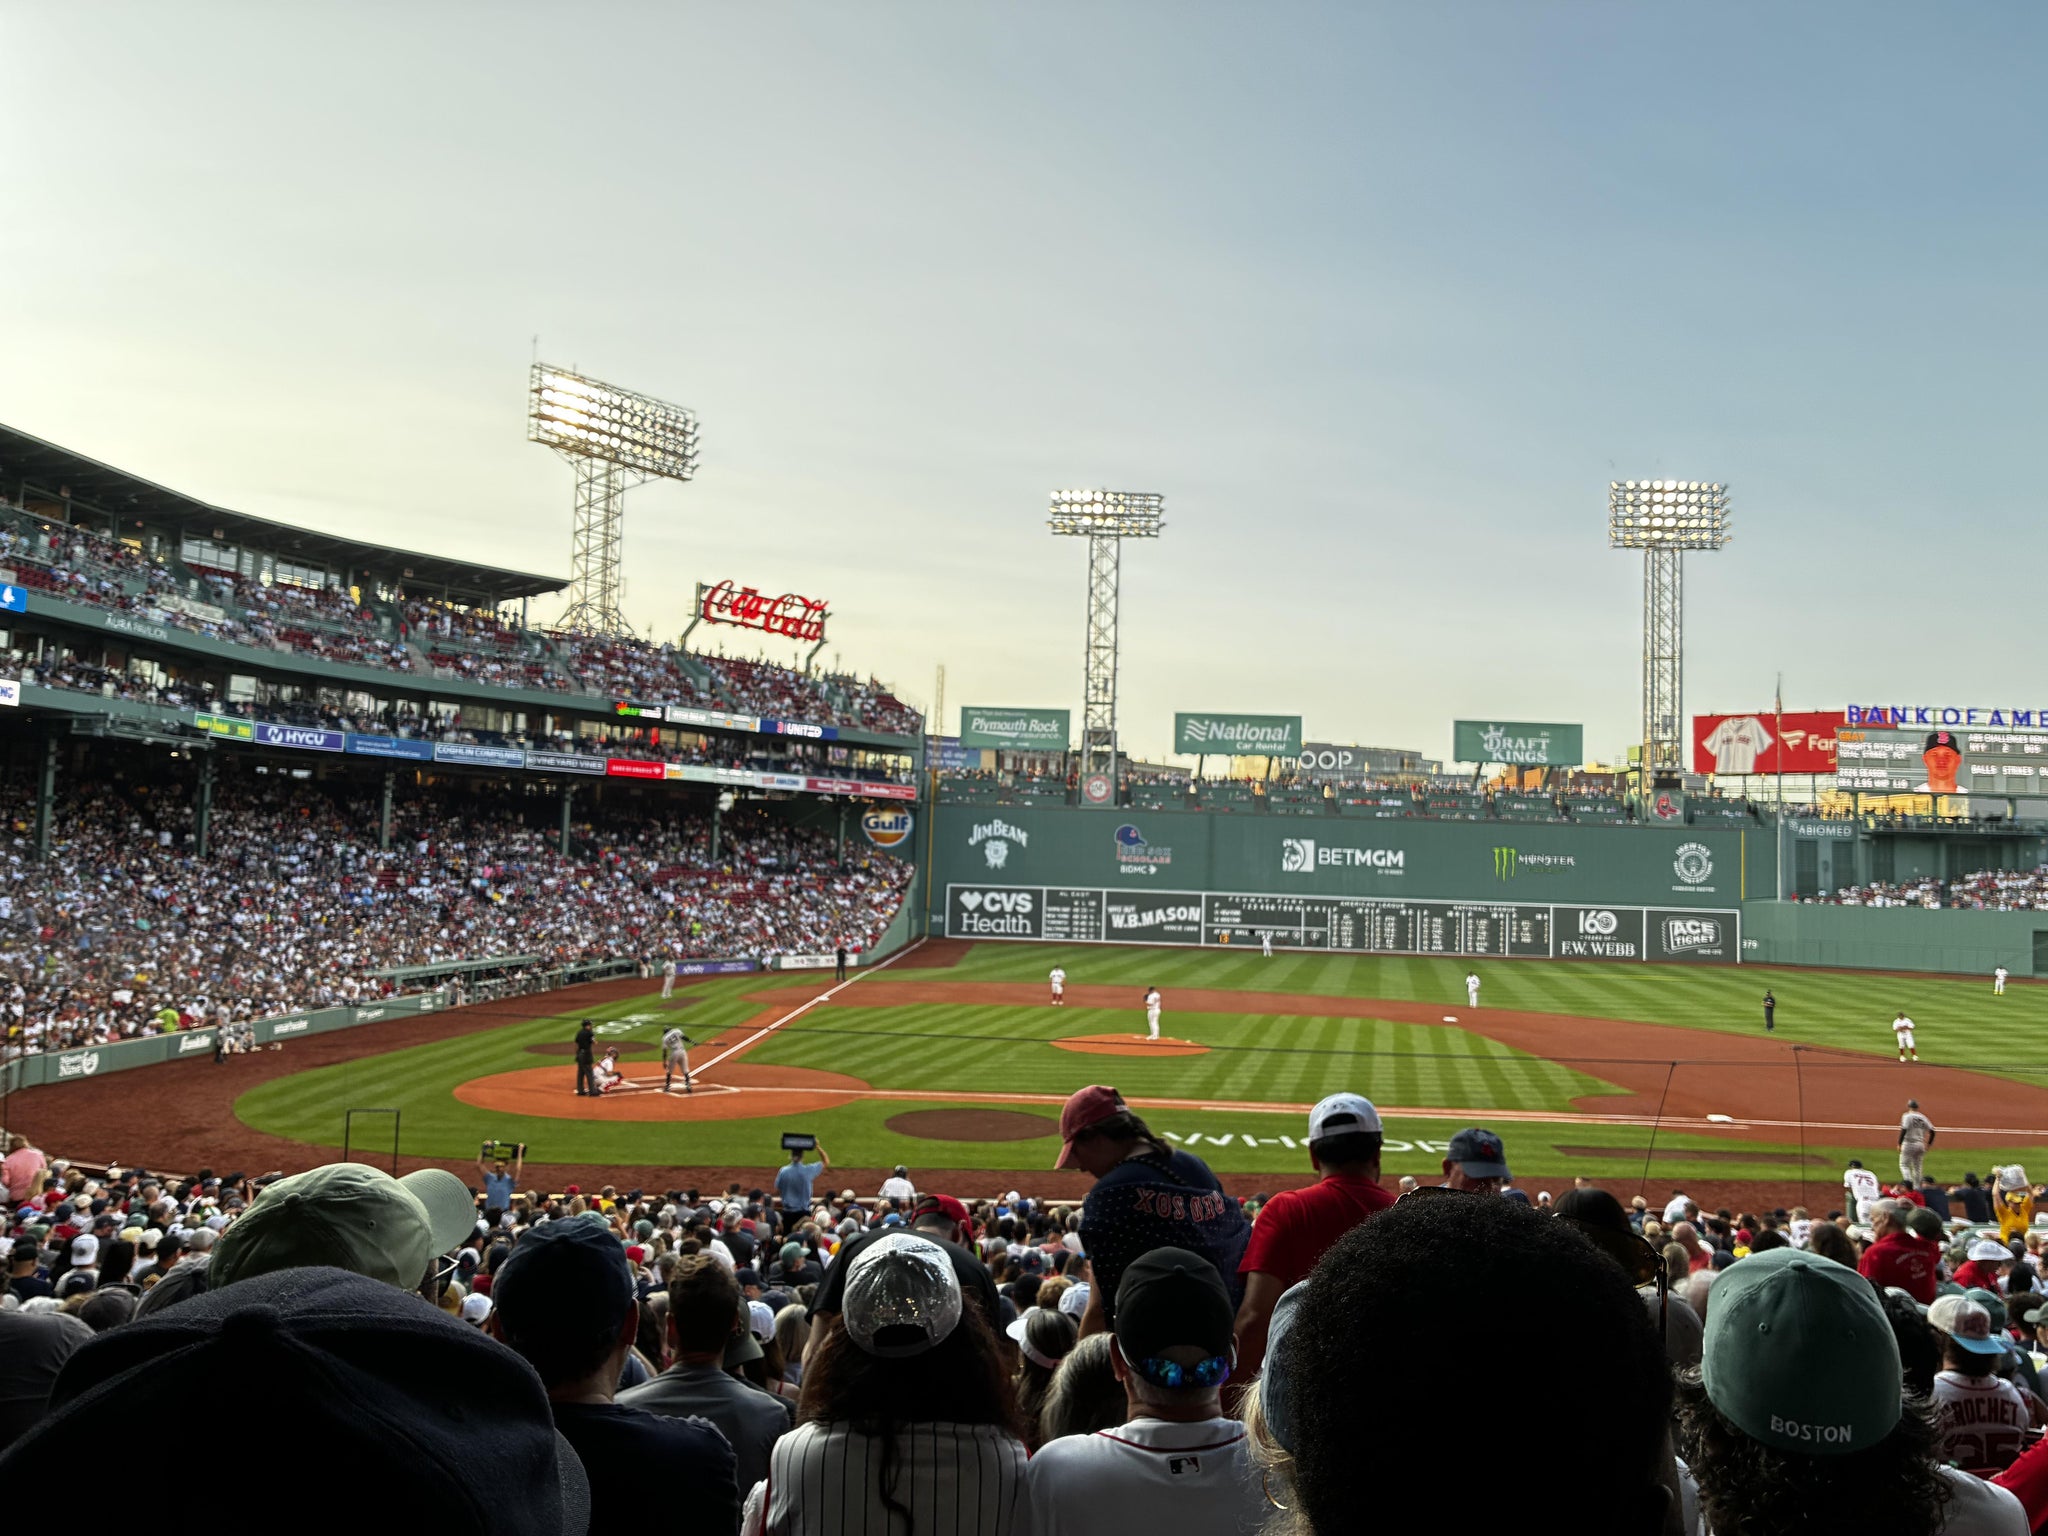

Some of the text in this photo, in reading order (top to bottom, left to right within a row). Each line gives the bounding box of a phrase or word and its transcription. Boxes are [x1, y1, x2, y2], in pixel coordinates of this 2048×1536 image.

[703, 579, 828, 641] Coca-Cola
[1847, 704, 1930, 725] BANK
[1942, 708, 1979, 725] OF
[971, 717, 1059, 733] Plymouth Rock
[1208, 721, 1291, 742] National
[286, 732, 325, 746] HYCU
[1236, 741, 1286, 752] Car Rental
[1483, 737, 1550, 753] DRAFT
[537, 757, 578, 769] VINEYARD
[1492, 751, 1548, 763] KINGS
[1971, 764, 1998, 775] BALLS
[2002, 765, 2035, 776] STRIKES
[863, 814, 910, 831] Gulf
[1798, 824, 1852, 837] ABIOMED
[968, 819, 1029, 848] JIM BEAM
[1318, 846, 1405, 868] BETMGM
[1518, 853, 1576, 867] MONSTER
[1120, 865, 1148, 874] BIDMC
[983, 891, 1033, 912] CVS
[961, 912, 1033, 934] Health
[1578, 910, 1618, 935] 160
[1674, 919, 1715, 936] ACE
[1561, 941, 1636, 957] F.W. WEBB
[1674, 935, 1716, 947] TICKET
[1132, 1187, 1226, 1223] RED SOX
[1770, 1413, 1852, 1443] BOSTON
